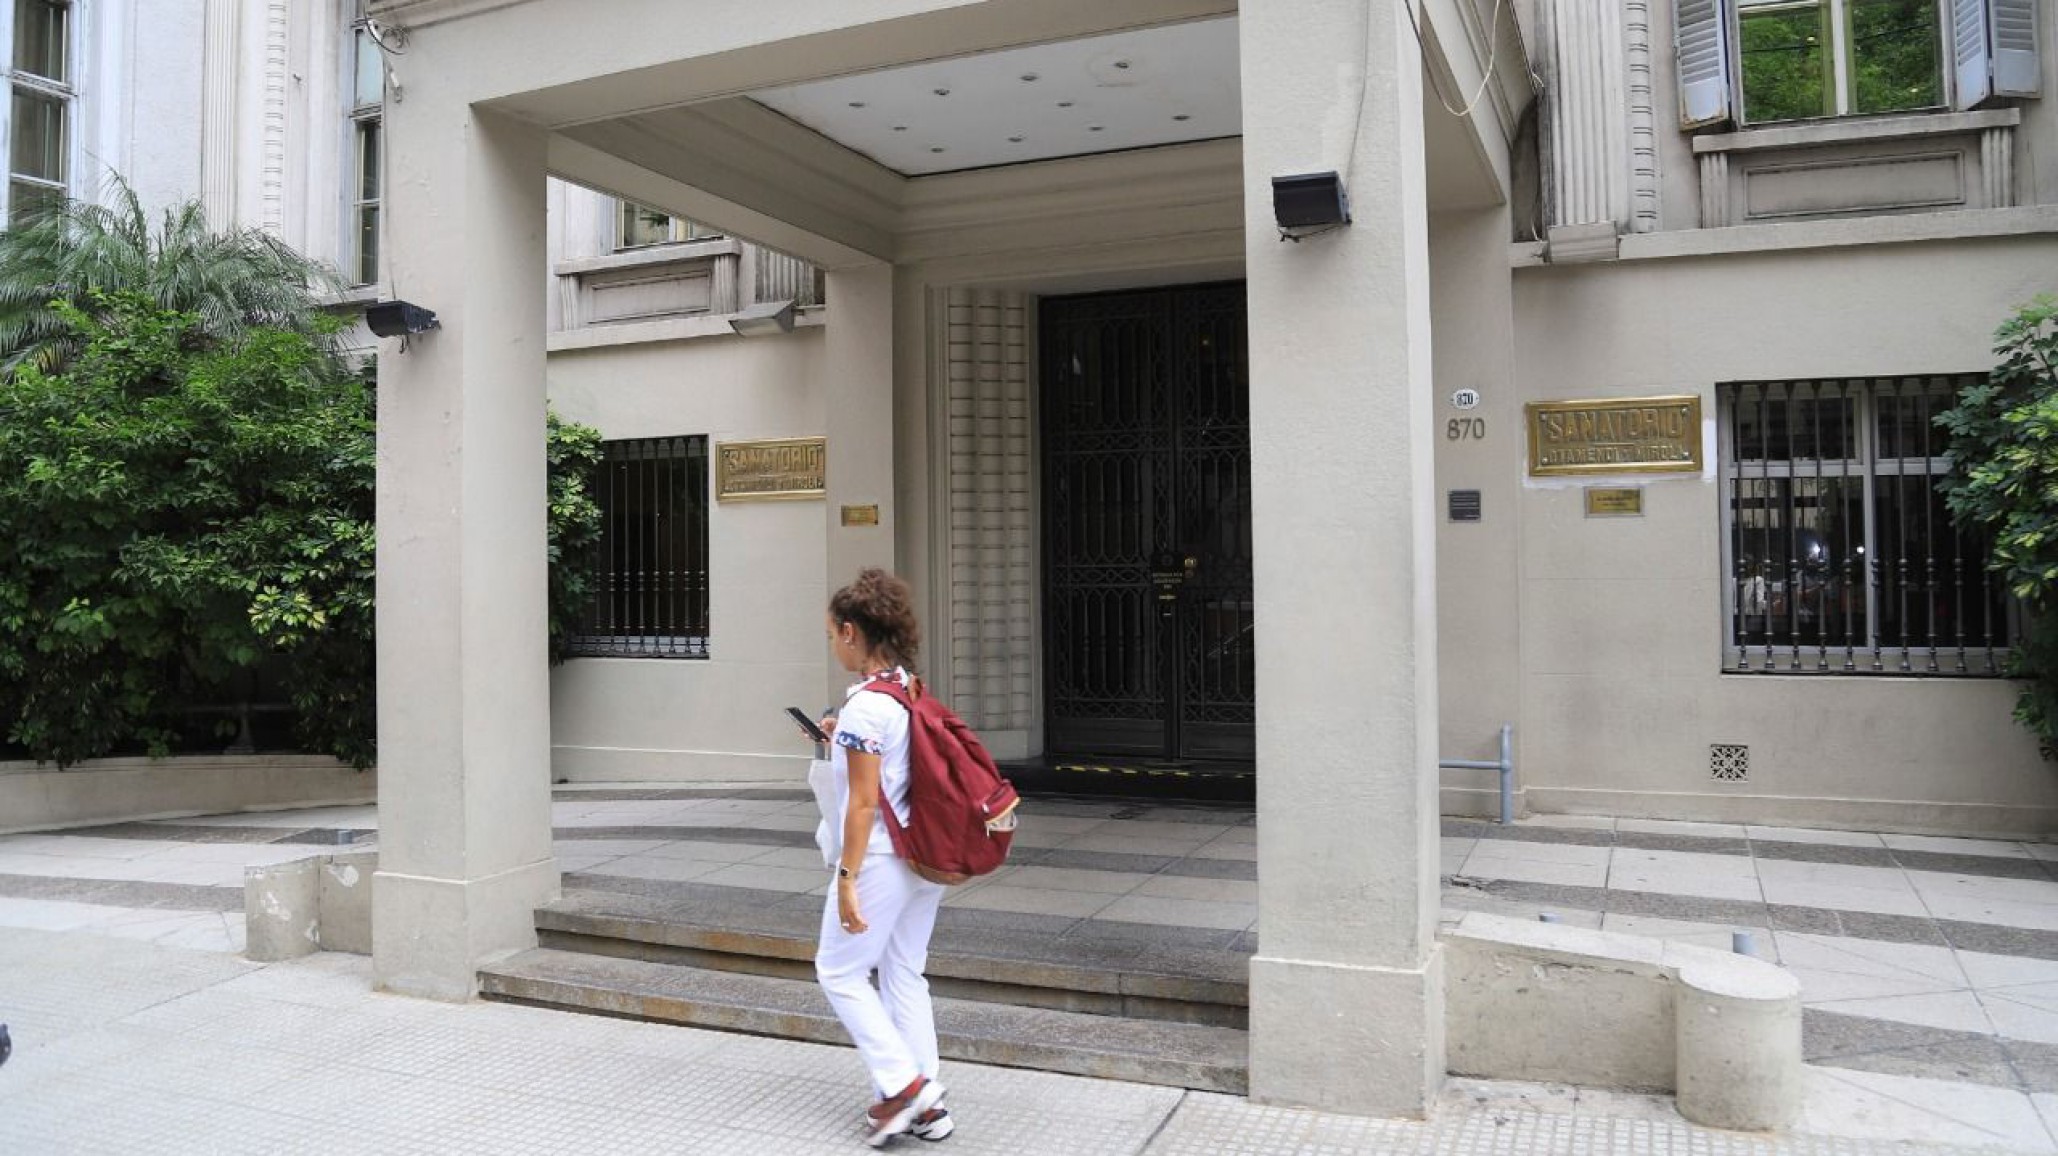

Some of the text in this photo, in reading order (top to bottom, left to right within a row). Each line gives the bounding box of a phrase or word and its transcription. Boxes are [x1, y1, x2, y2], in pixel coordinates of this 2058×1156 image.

[1456, 392, 1474, 407] 870
[1447, 417, 1486, 441] 870
[1547, 408, 1685, 443] SANATORIO
[729, 446, 820, 473] SANATORIO
